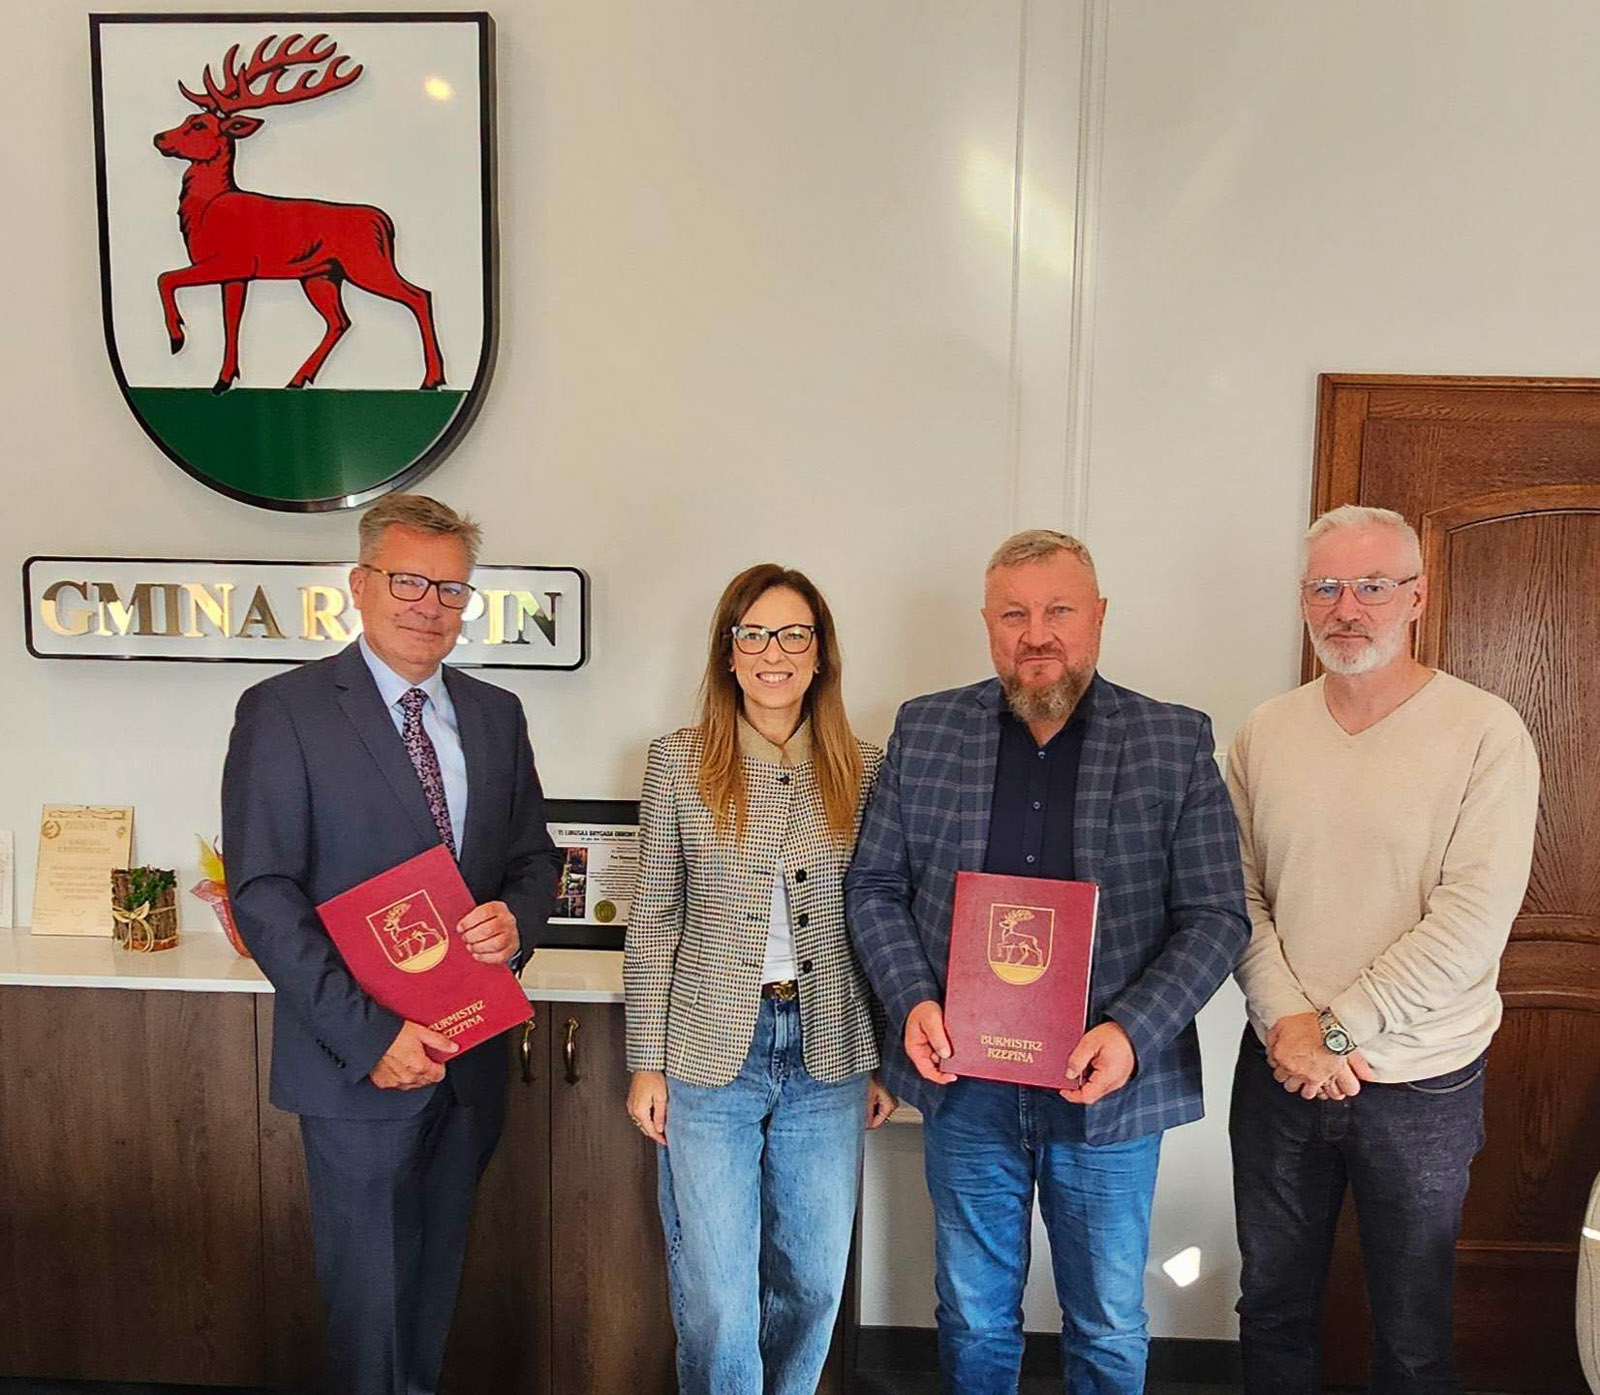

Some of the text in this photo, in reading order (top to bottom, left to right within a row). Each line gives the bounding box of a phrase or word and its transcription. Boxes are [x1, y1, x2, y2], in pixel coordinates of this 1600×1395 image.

[40, 580, 562, 647] GMINA RPIN
[429, 1000, 486, 1031] URMISTRZ
[980, 1034, 1043, 1051] BURMISTRZ
[987, 1048, 1034, 1063] RZEPINA
